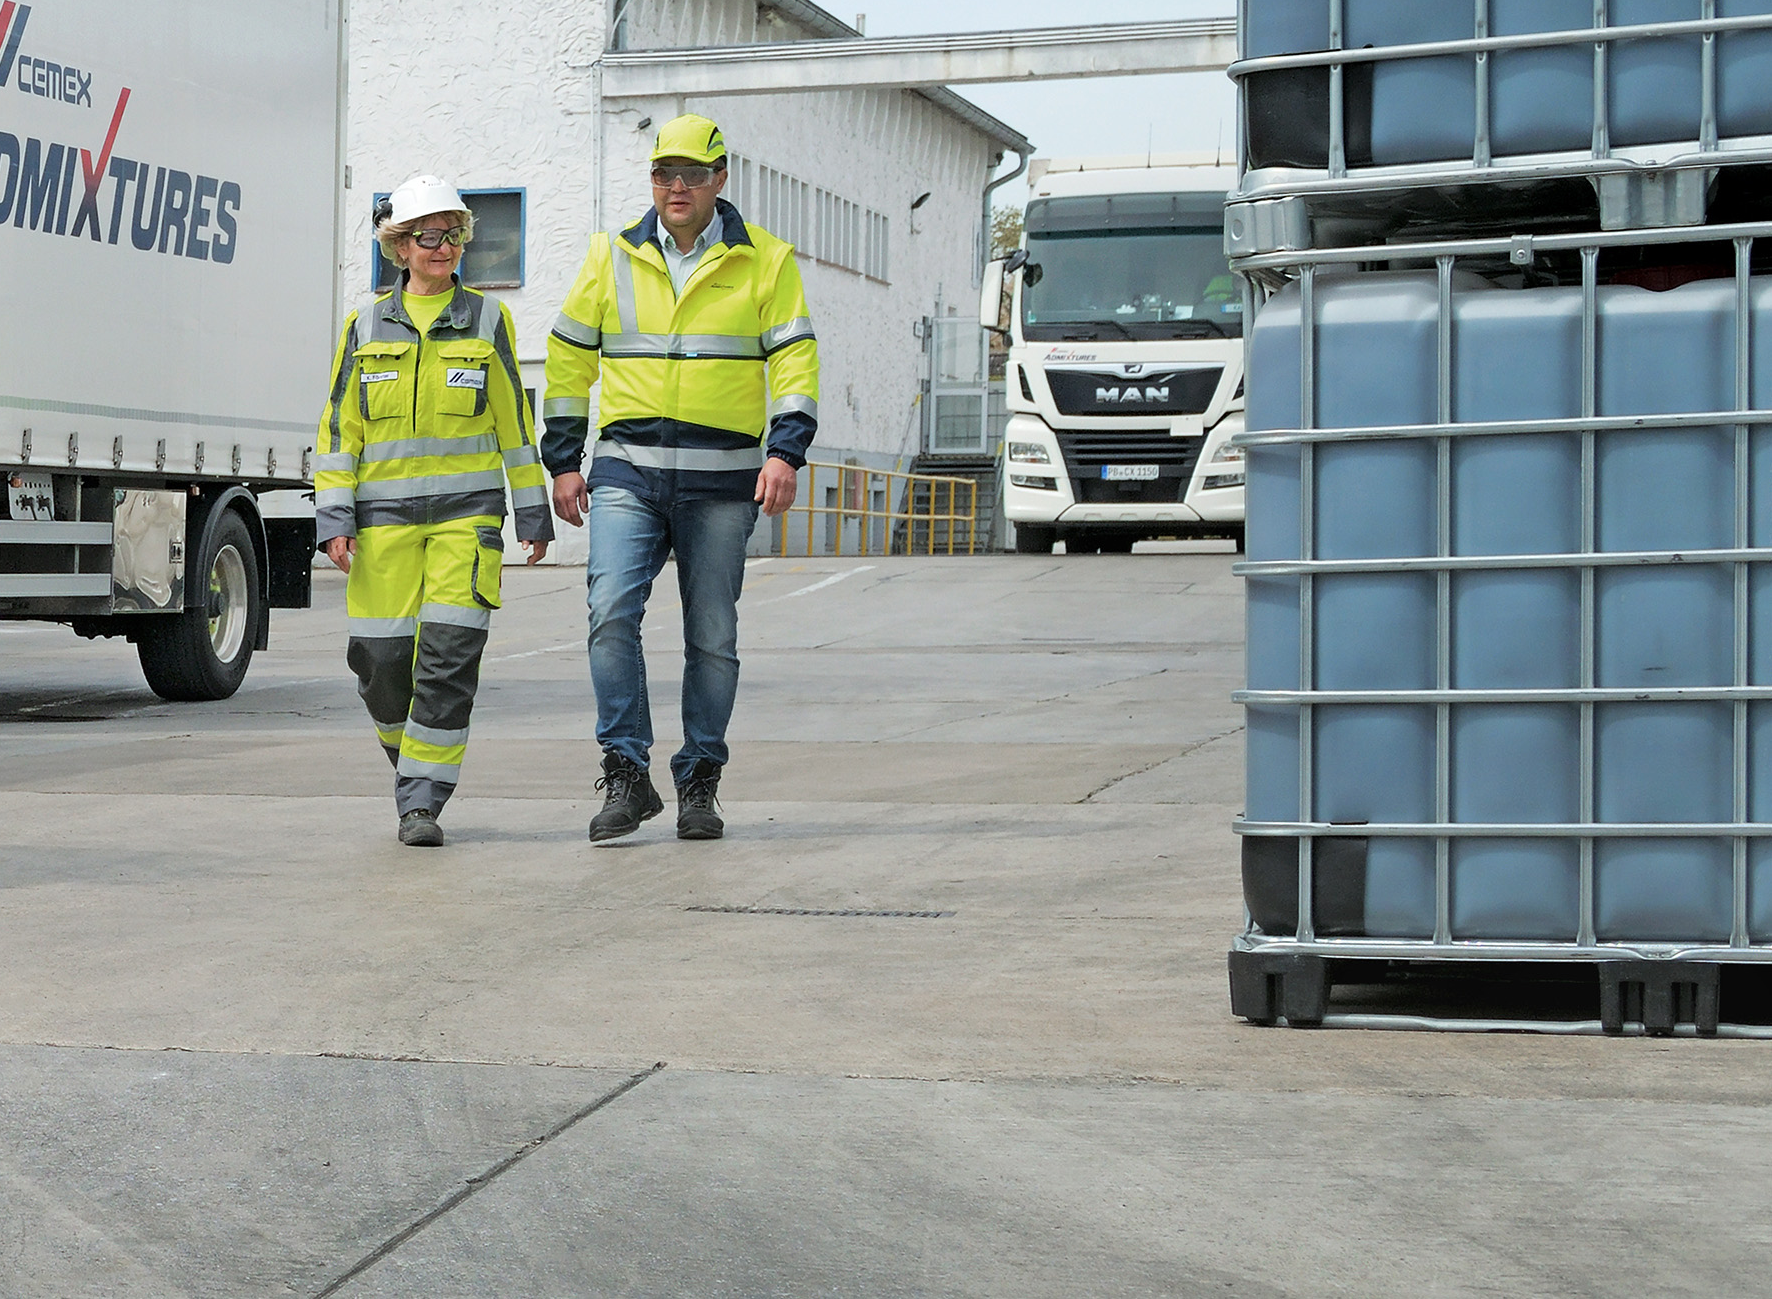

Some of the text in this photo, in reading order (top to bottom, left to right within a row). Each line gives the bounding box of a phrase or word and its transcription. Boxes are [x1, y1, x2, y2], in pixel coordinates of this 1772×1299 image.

[18, 55, 92, 108] CEMEX
[1043, 350, 1097, 361] ADMIXTURES
[1096, 387, 1169, 403] MAN
